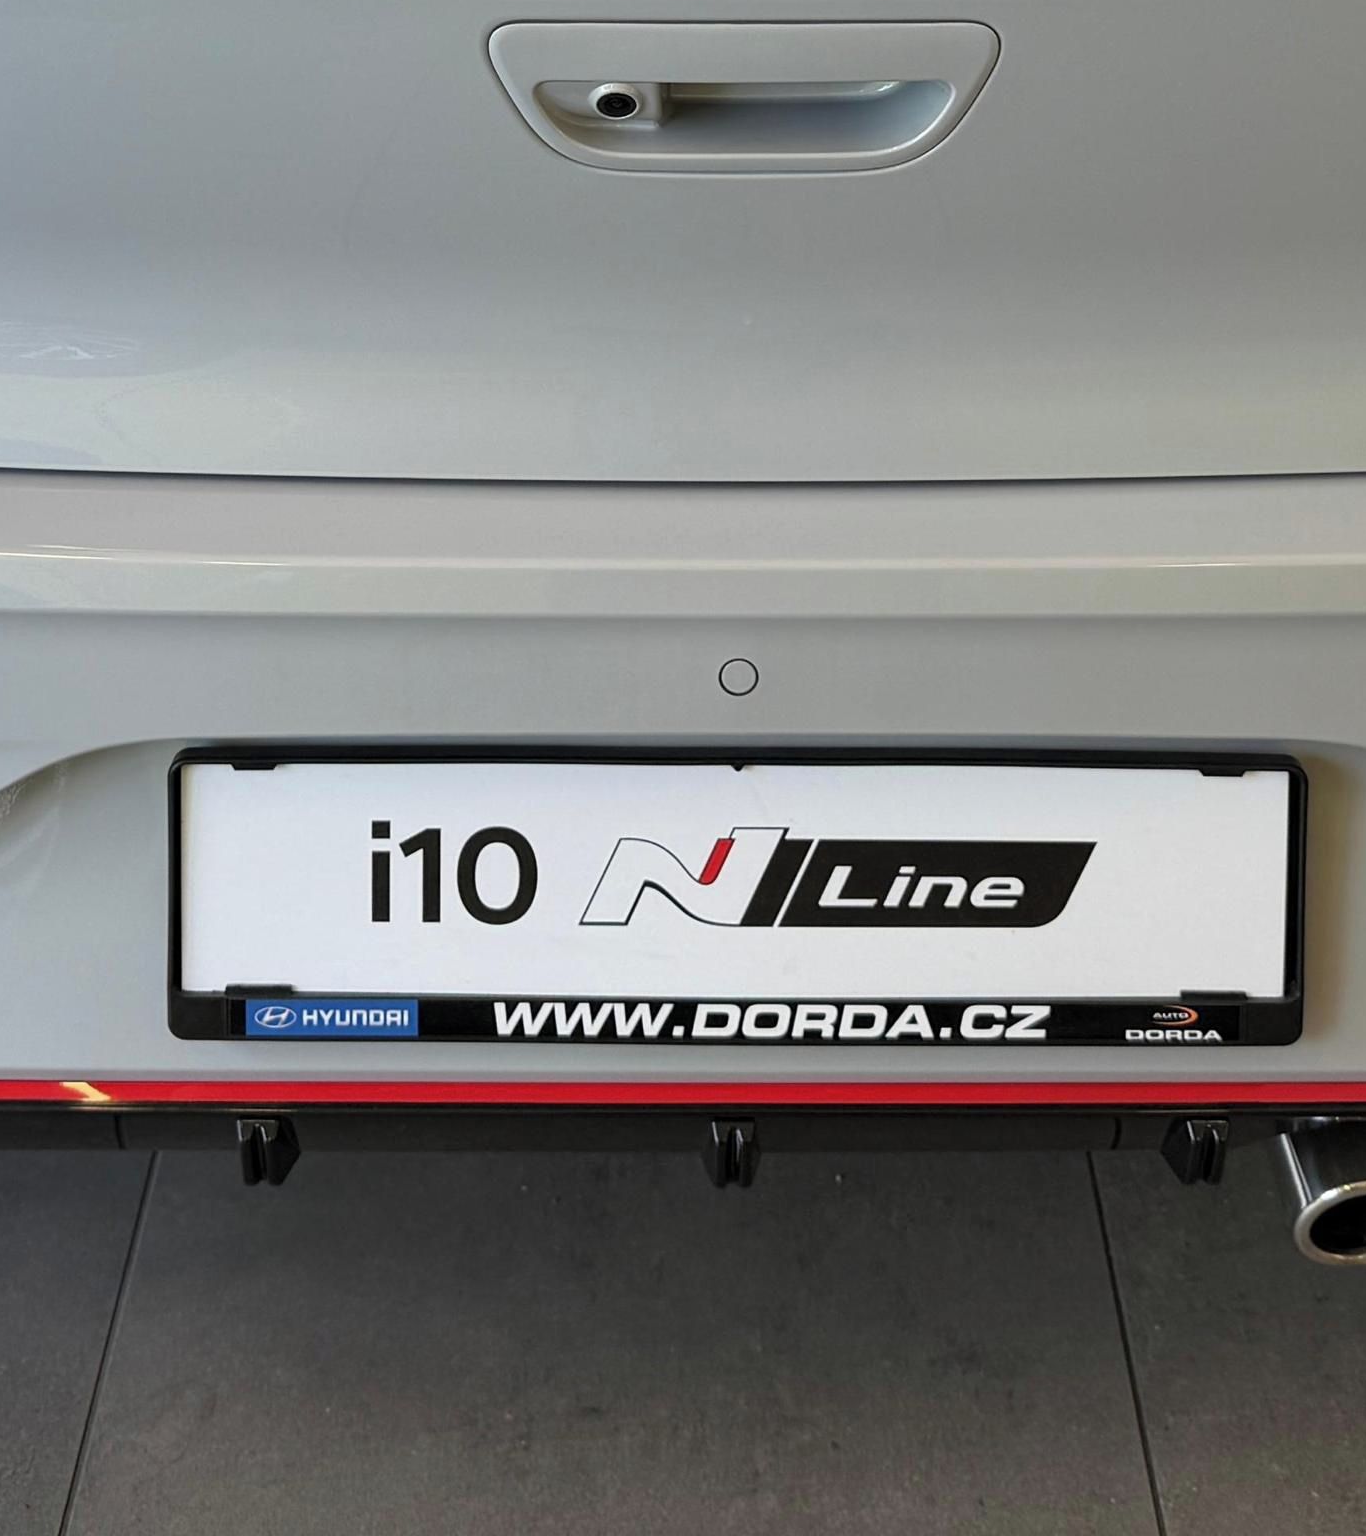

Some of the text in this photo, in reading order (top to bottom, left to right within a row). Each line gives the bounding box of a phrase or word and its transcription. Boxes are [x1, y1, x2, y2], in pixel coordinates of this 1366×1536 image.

[370, 819, 539, 926] i10
[817, 865, 1026, 909] Line
[301, 1008, 409, 1027] HYUNDAI
[492, 1001, 1052, 1040] WWW.DORDA.CZ
[1152, 1011, 1190, 1021] AUTO
[1124, 1028, 1223, 1042] DORDA
